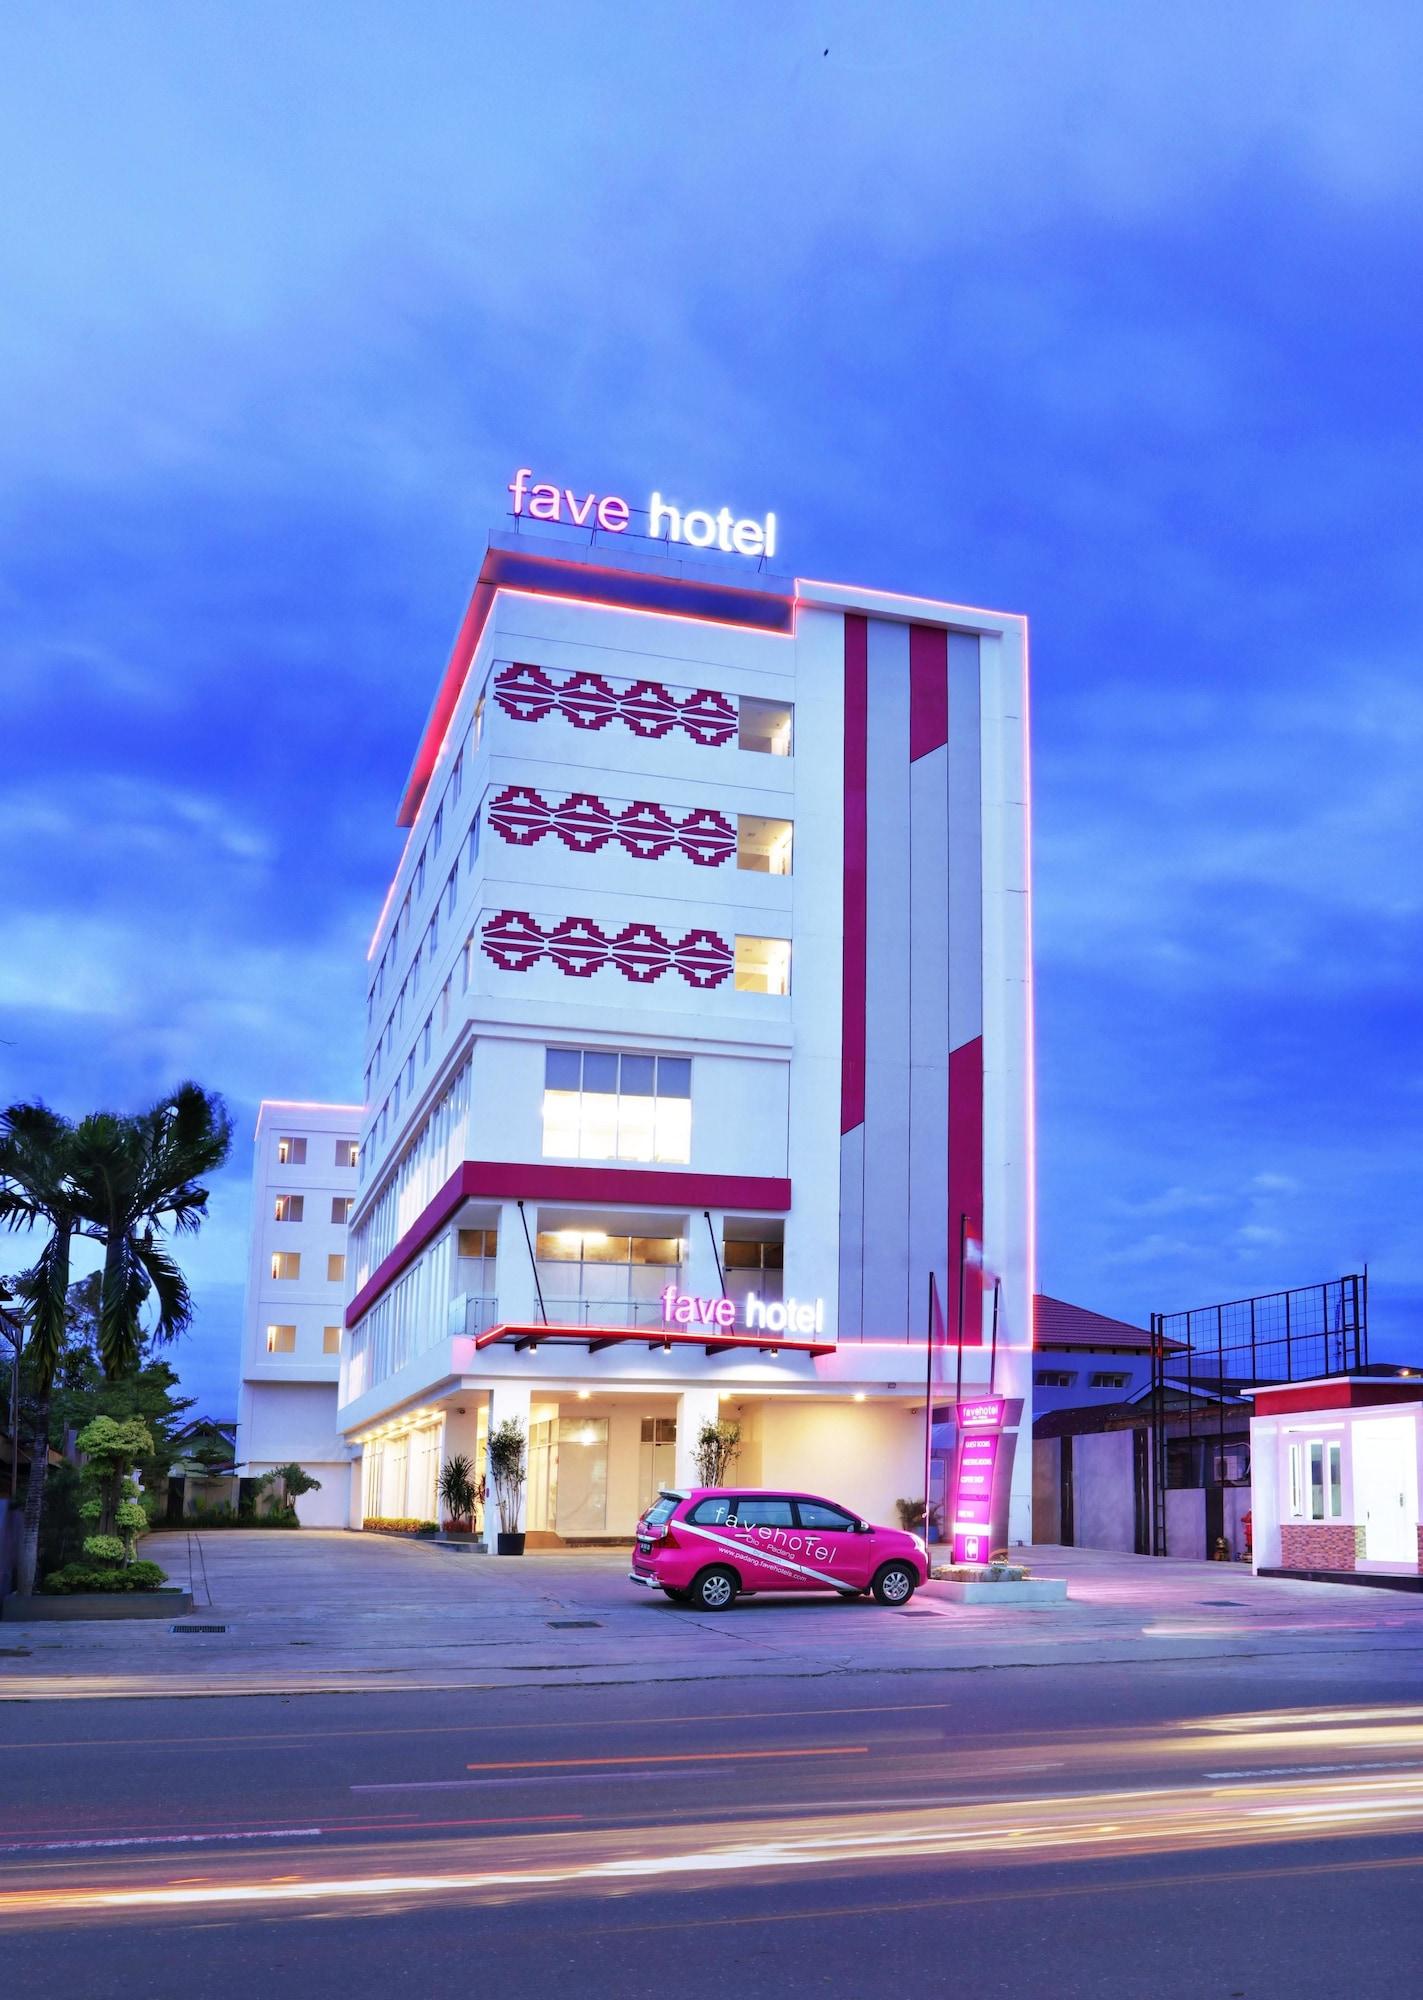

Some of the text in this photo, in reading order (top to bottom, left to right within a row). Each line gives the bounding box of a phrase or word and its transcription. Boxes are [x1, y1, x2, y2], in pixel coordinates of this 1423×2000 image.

[508, 468, 775, 557] fave hotel
[663, 1285, 824, 1333] fave hotel
[715, 1506, 837, 1564] favehotel
[766, 1543, 796, 1559] Padang
